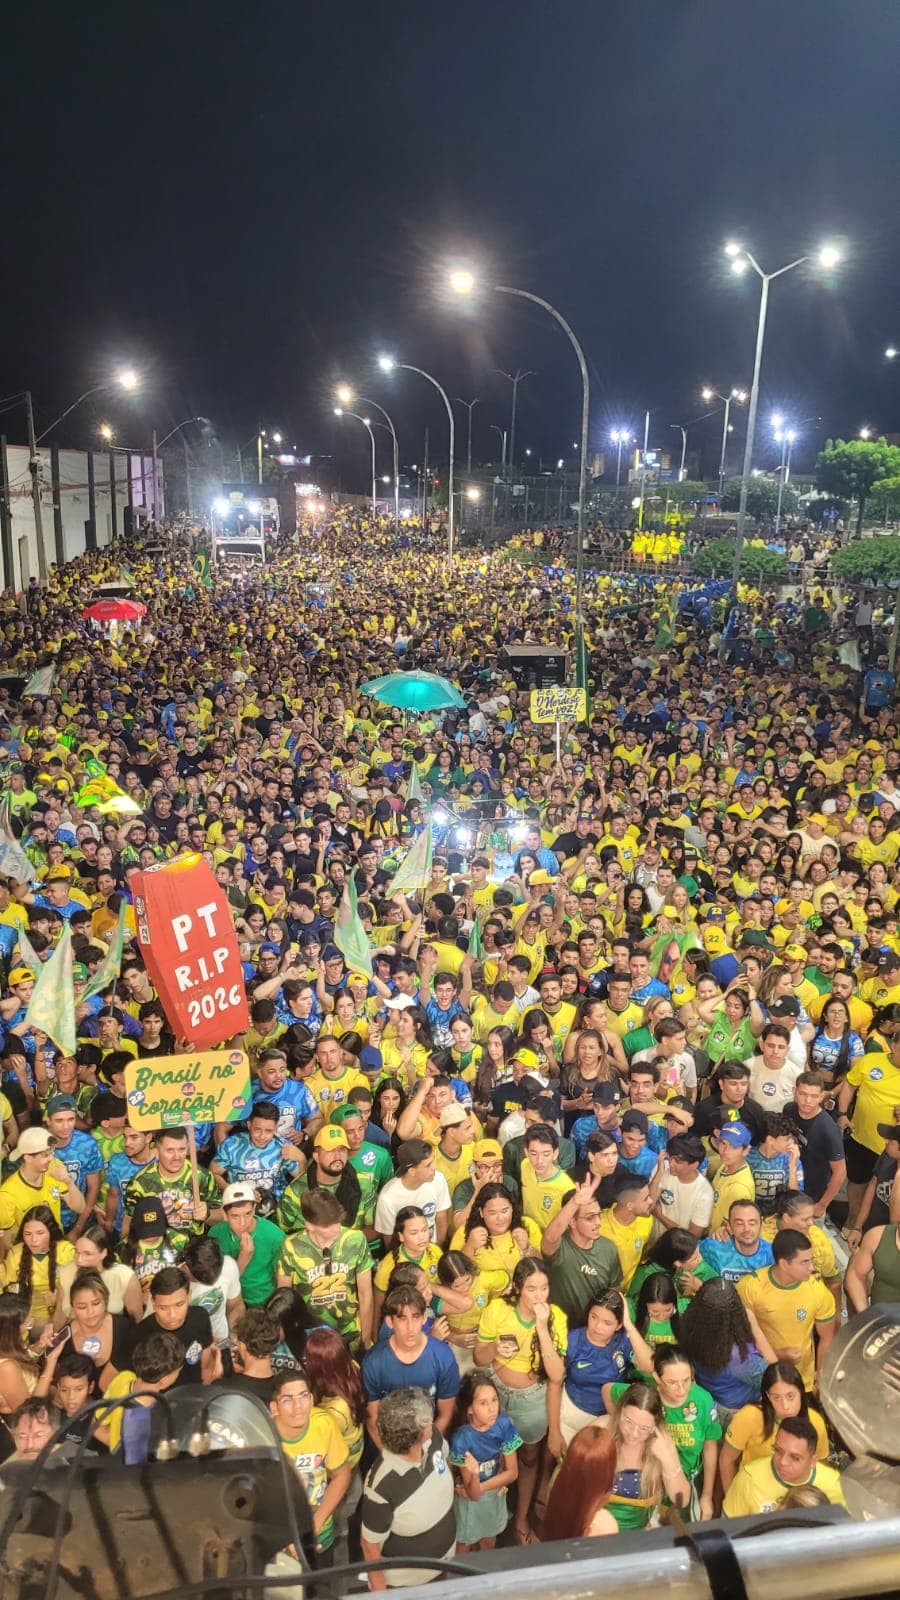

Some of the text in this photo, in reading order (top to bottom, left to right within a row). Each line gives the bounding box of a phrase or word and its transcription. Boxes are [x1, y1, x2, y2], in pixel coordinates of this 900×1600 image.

[545, 694, 581, 708] Nordeste
[537, 707, 555, 718] tem
[171, 902, 218, 953] PT
[174, 947, 230, 992] R.I.P
[187, 984, 241, 1028] 2026
[135, 1062, 236, 1091] Brasil no
[764, 1085, 777, 1093] 22
[195, 1110, 213, 1121] 22
[245, 1160, 259, 1168] 22
[306, 1262, 338, 1283] BLOO
[311, 1272, 347, 1297] 22
[82, 1341, 100, 1351] 22
[271, 1357, 295, 1369] LOCO
[208, 1420, 245, 1449] EAM
[297, 1456, 312, 1468] 22
